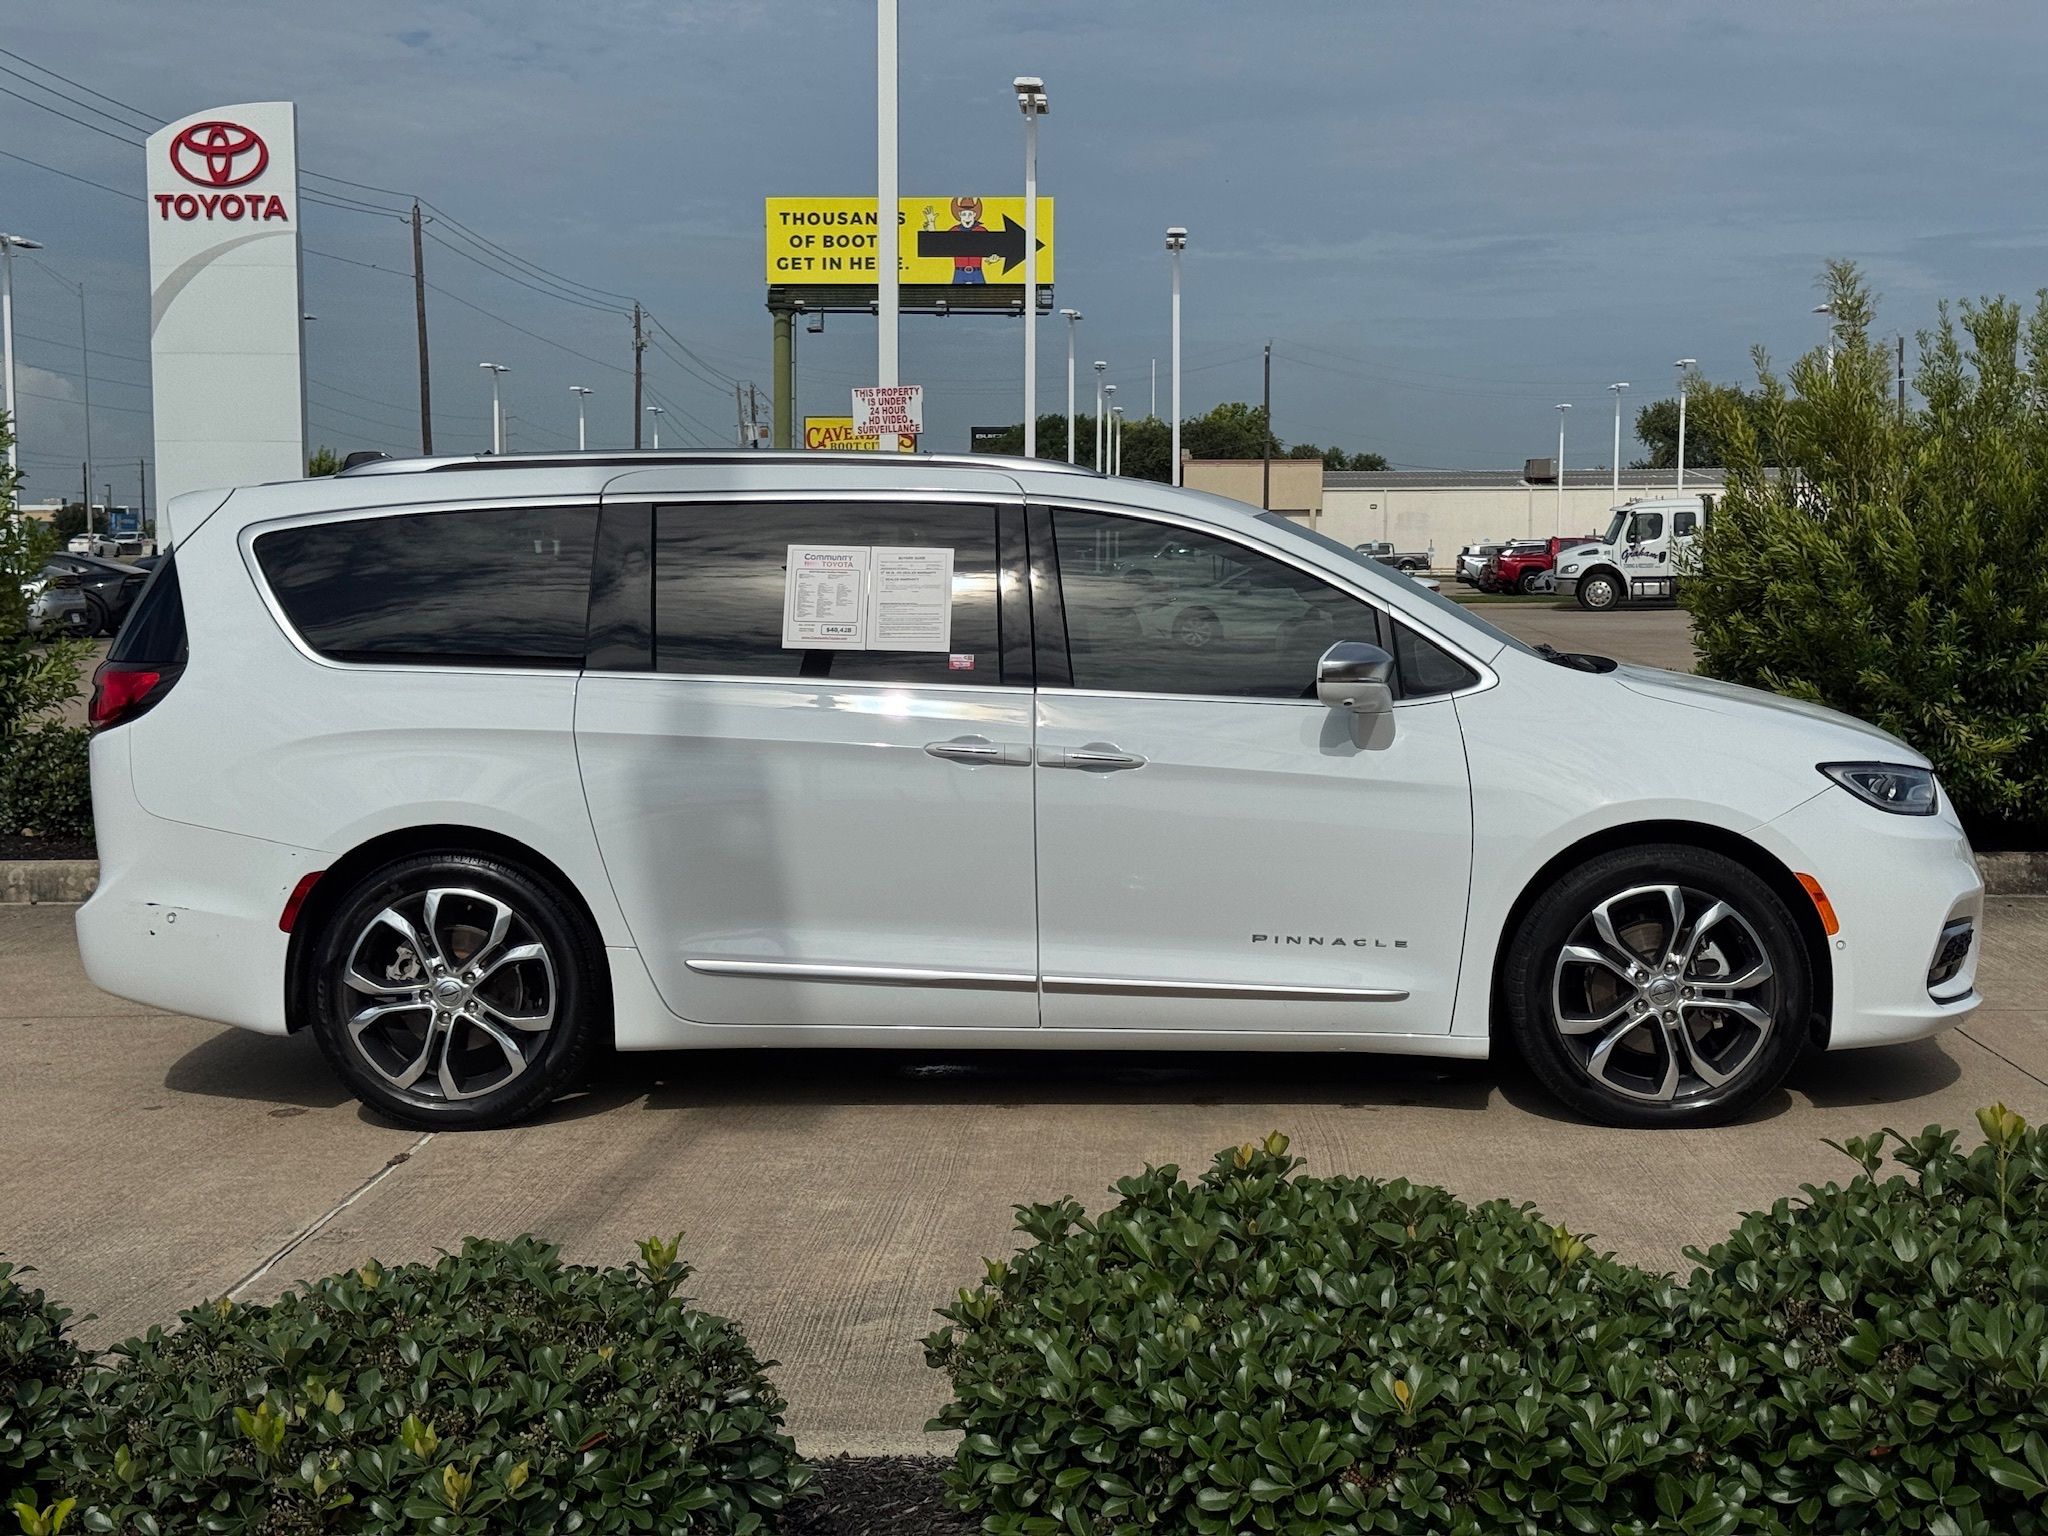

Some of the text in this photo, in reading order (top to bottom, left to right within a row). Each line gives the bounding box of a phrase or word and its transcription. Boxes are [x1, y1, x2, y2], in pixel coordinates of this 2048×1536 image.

[154, 194, 288, 221] TOYOTA
[779, 212, 906, 225] THOUSANS
[789, 235, 878, 248] OF BOOT
[776, 257, 815, 270] GET
[822, 257, 842, 270] IN
[854, 387, 920, 398] THIS PROPERTY
[867, 396, 907, 406] IS UNDER
[870, 405, 906, 415] 24 HOUR
[868, 414, 908, 425] HD VIDEO
[857, 423, 921, 435] SURVEILLANCE
[1252, 934, 1409, 948] PINNACLE
